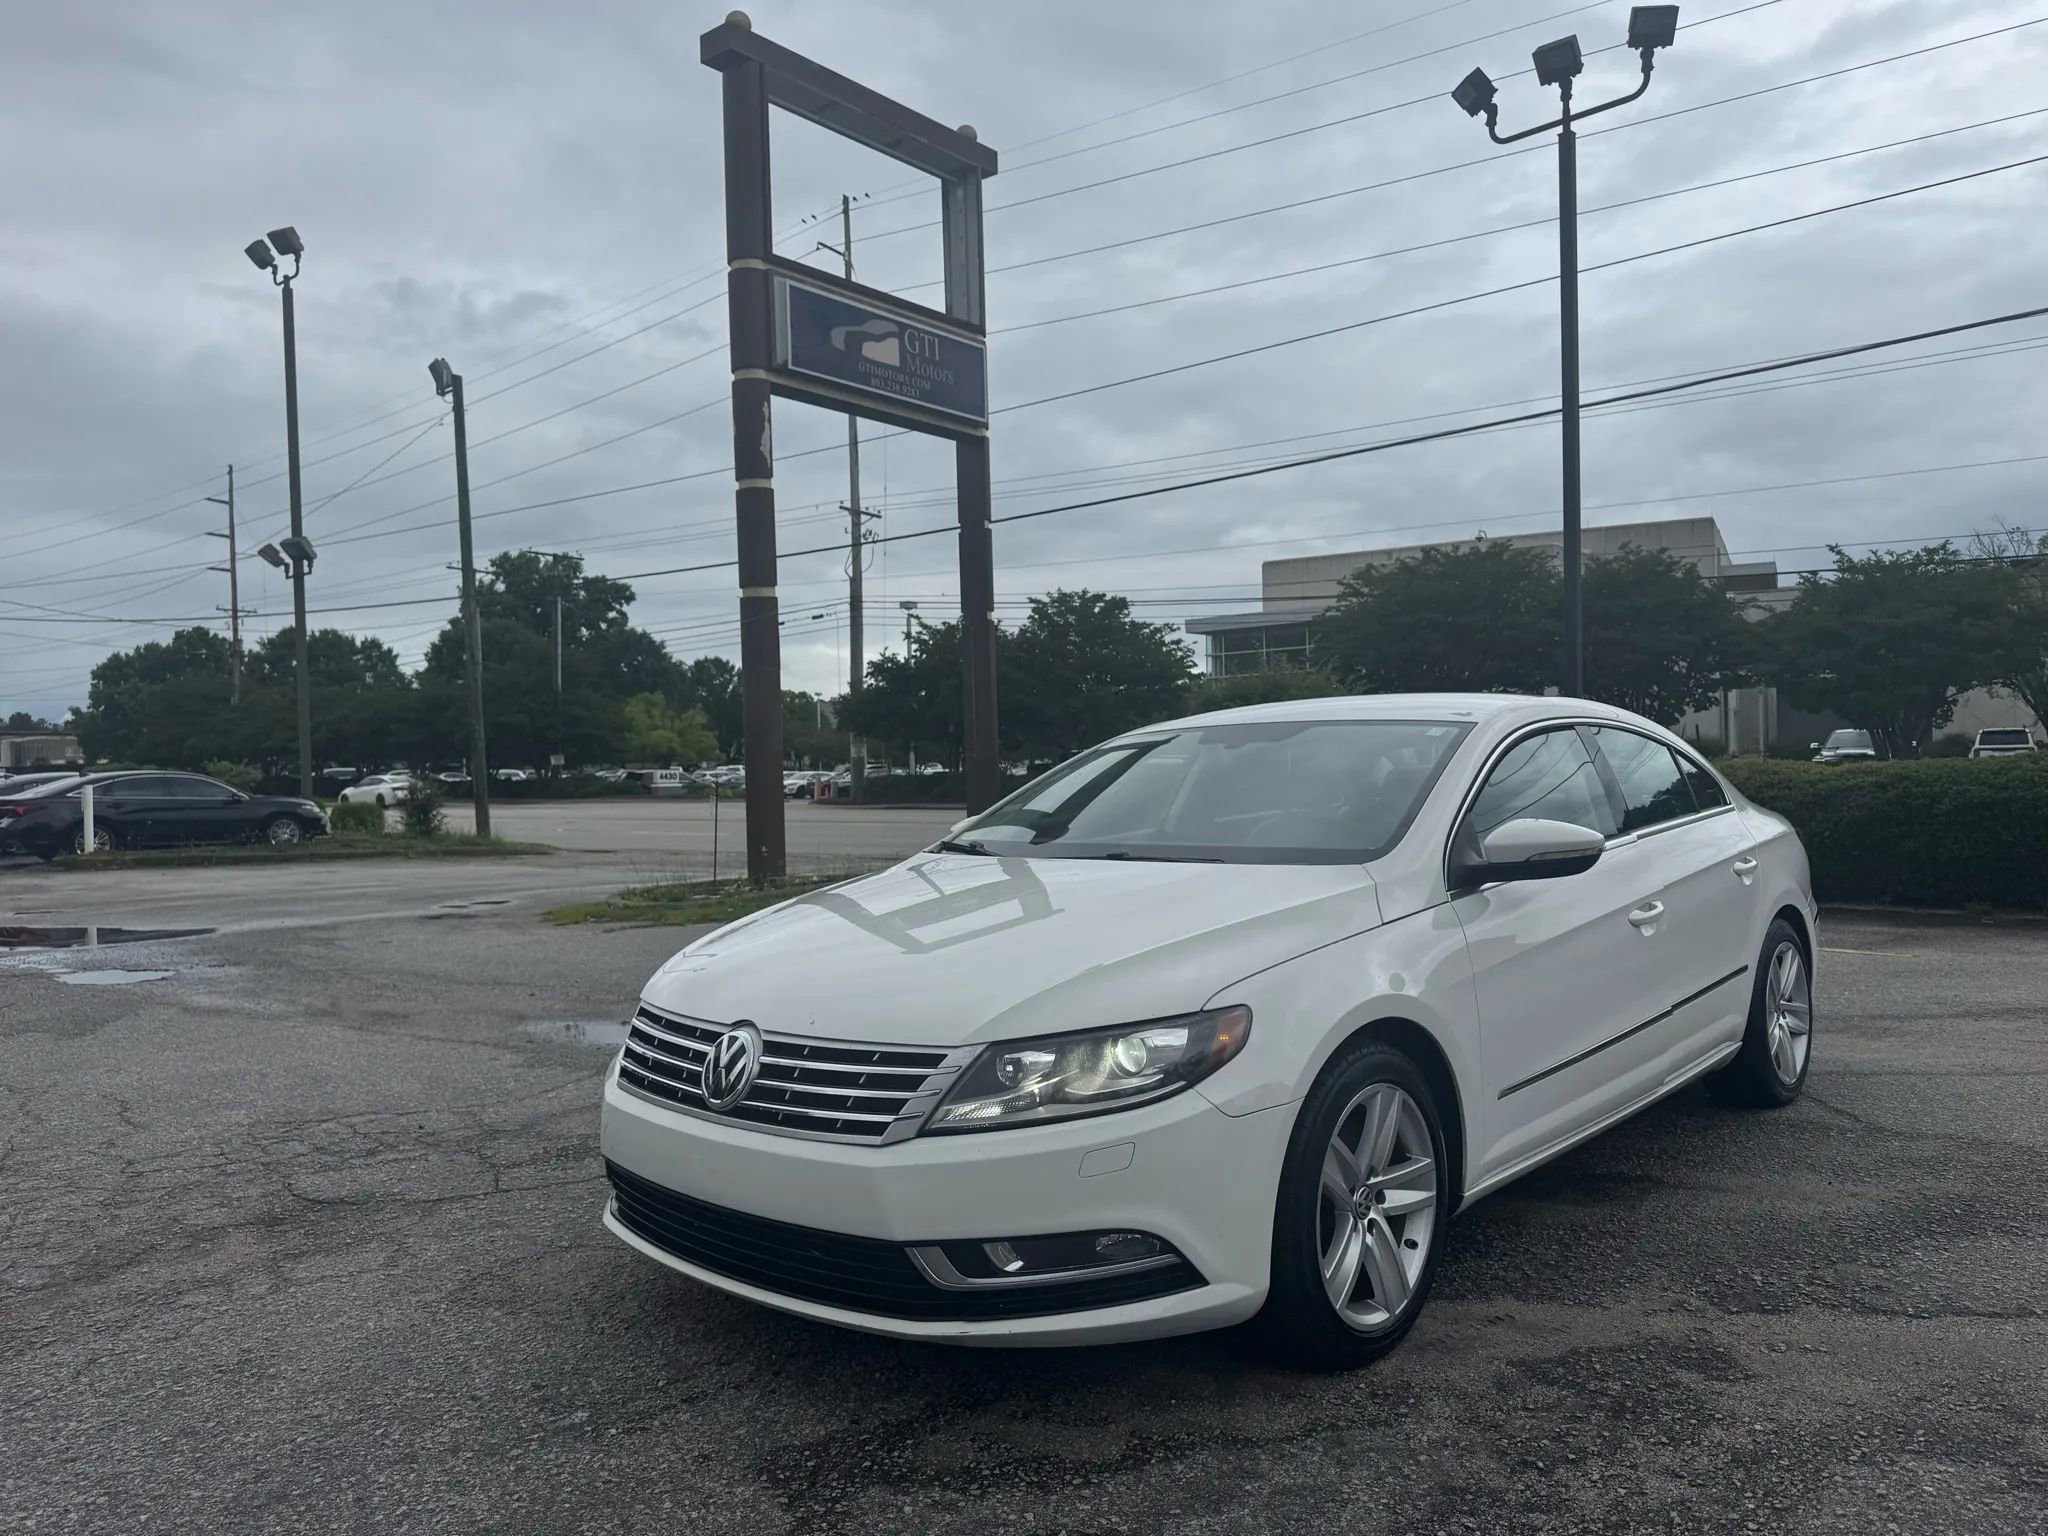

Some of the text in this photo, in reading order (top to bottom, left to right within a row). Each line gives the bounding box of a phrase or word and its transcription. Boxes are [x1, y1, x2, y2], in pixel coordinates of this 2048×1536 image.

[904, 329, 939, 361] GTI
[858, 361, 931, 392] GTIMOTORS.COM
[906, 353, 954, 385] Motors
